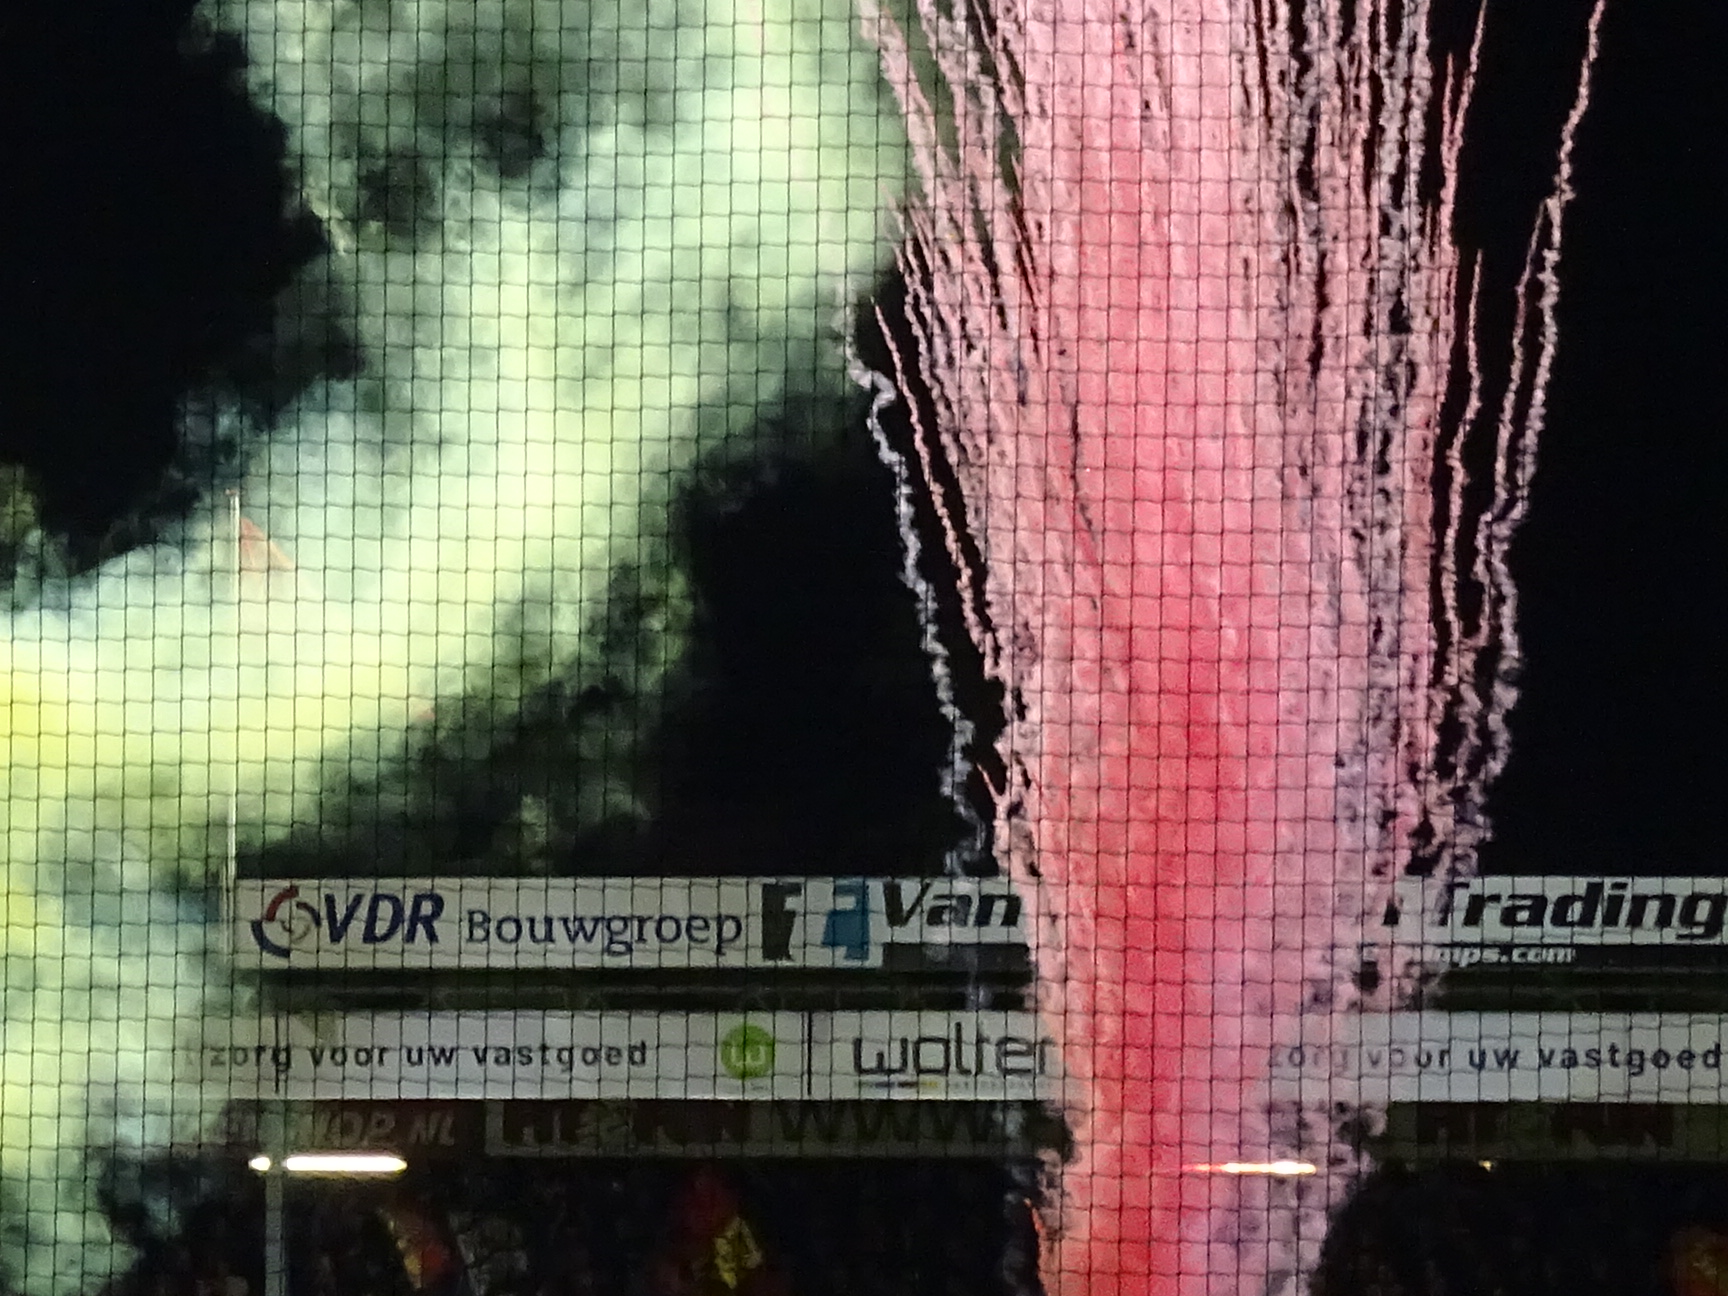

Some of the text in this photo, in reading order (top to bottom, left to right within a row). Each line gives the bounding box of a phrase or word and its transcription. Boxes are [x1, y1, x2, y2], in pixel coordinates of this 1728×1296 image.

[882, 881, 1022, 927] Van
[325, 893, 744, 956] VDR Bouwgroep
[311, 1046, 388, 1067] voor
[406, 1045, 454, 1067] uw
[473, 1041, 647, 1073] vastgoed
[1468, 1047, 1519, 1070] uw
[1538, 1043, 1722, 1076] vastgoed
